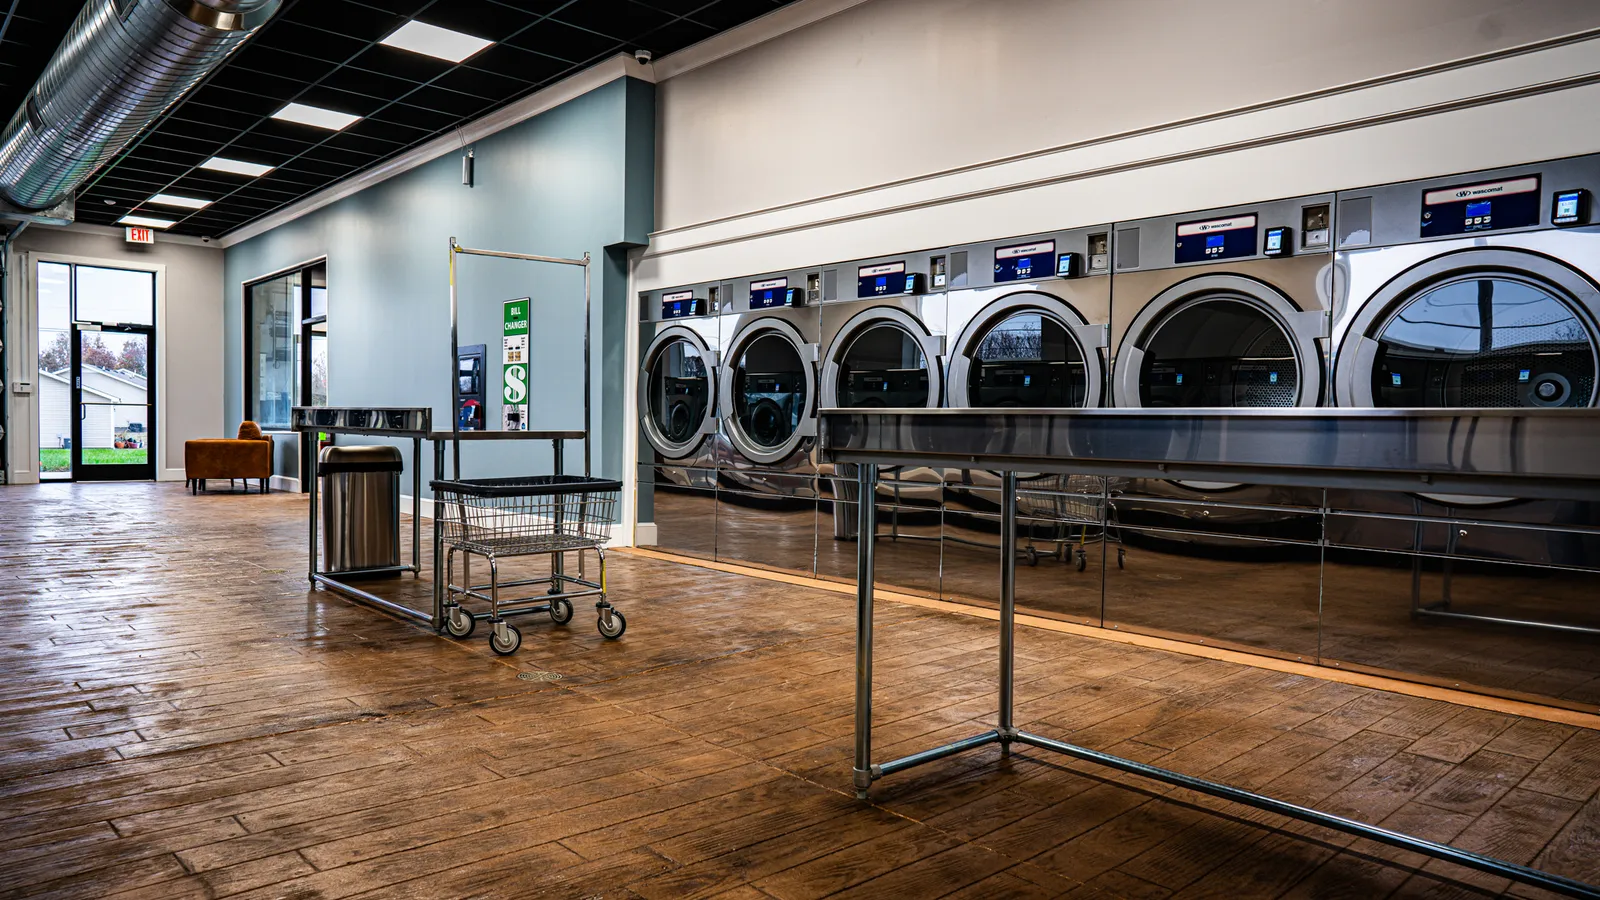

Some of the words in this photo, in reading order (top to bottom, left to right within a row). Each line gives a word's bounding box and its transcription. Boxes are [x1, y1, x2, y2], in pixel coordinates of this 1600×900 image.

[1472, 186, 1503, 195] wascomat
[131, 228, 150, 241] EXIT
[510, 307, 521, 316] BILL
[504, 320, 528, 330] CHANGER
[504, 365, 527, 403] $
